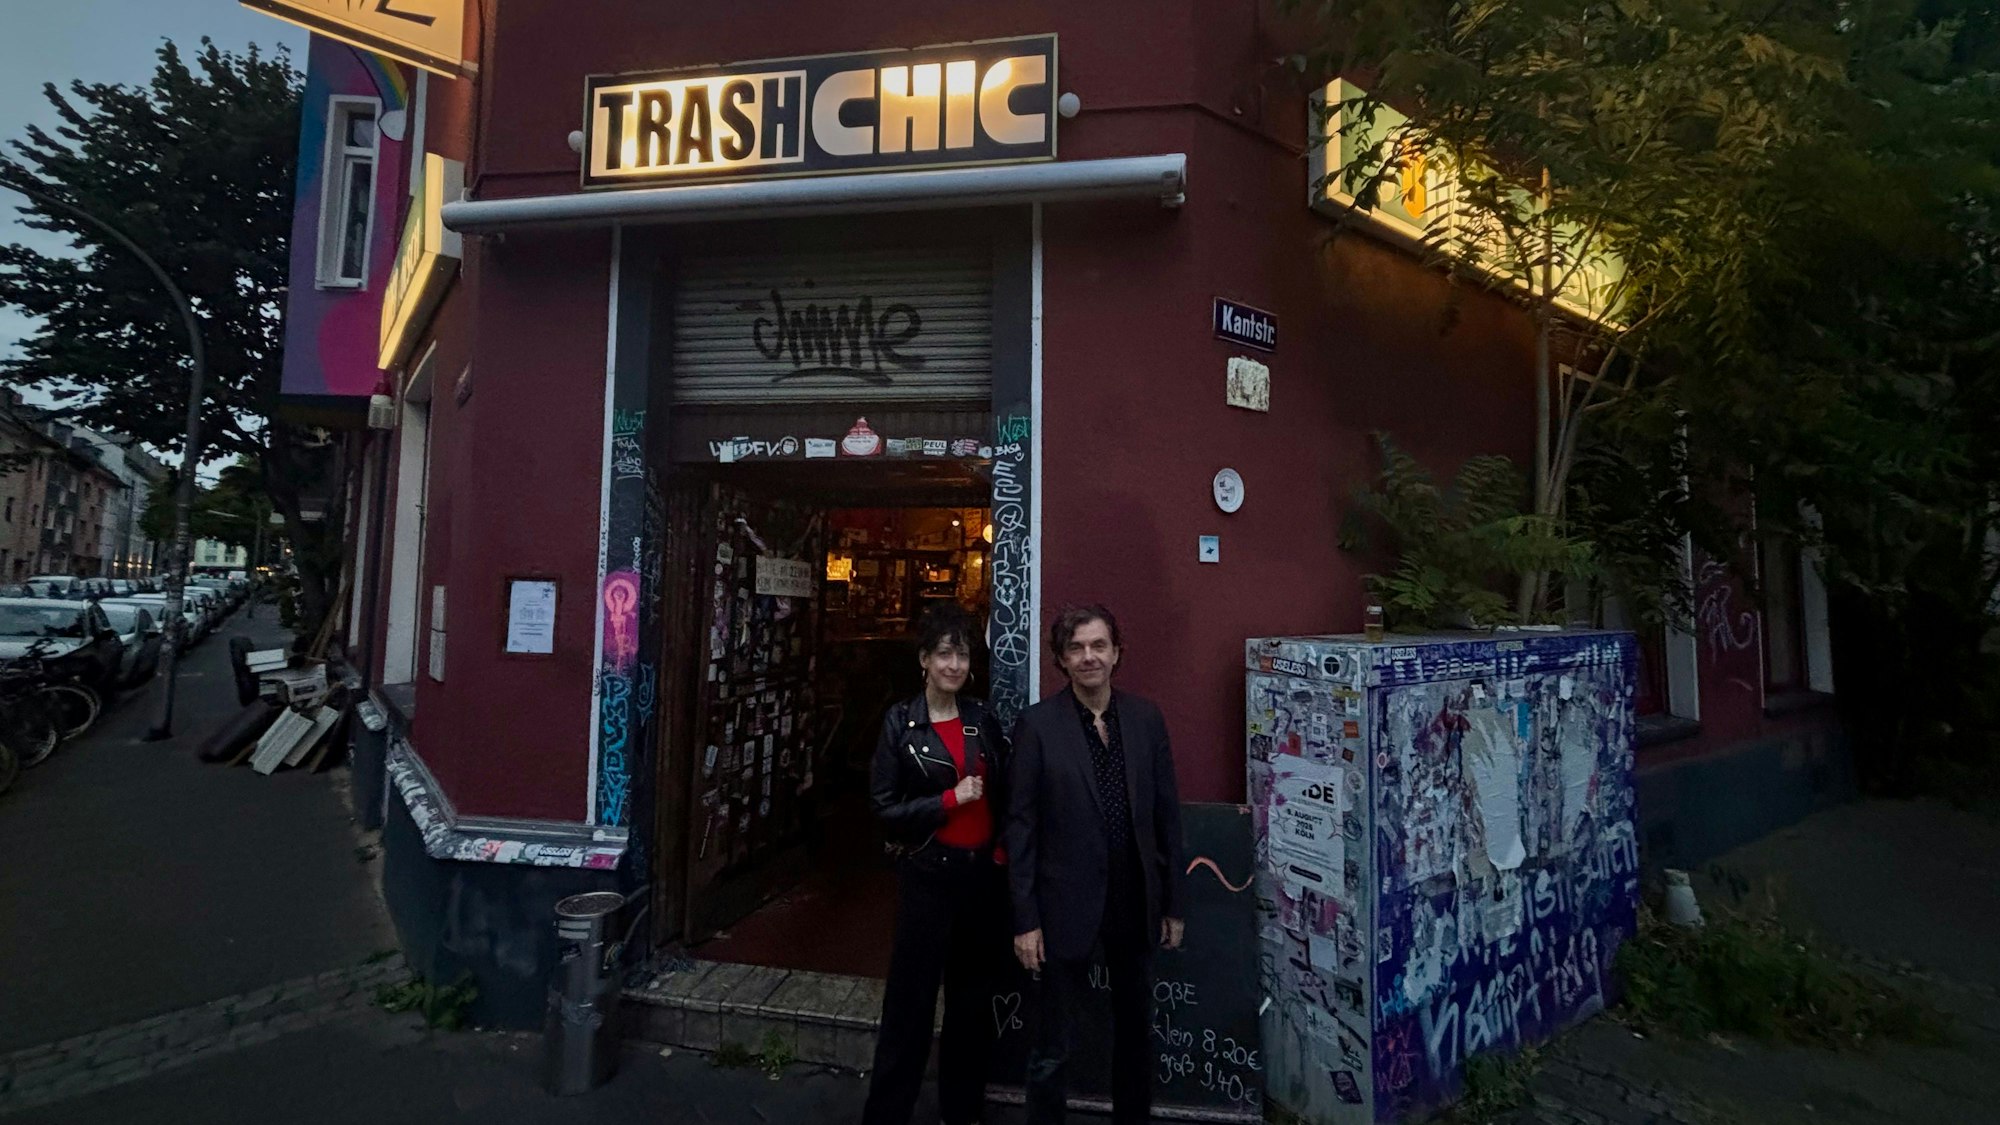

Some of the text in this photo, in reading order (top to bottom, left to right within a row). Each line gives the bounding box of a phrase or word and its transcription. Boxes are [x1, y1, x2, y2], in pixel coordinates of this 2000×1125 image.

[599, 54, 1047, 170] TRASH CHIC
[1222, 304, 1275, 345] Kantstr.
[1202, 1029, 1263, 1071] 8,20€
[1159, 1053, 1260, 1106] groß 9,40€
